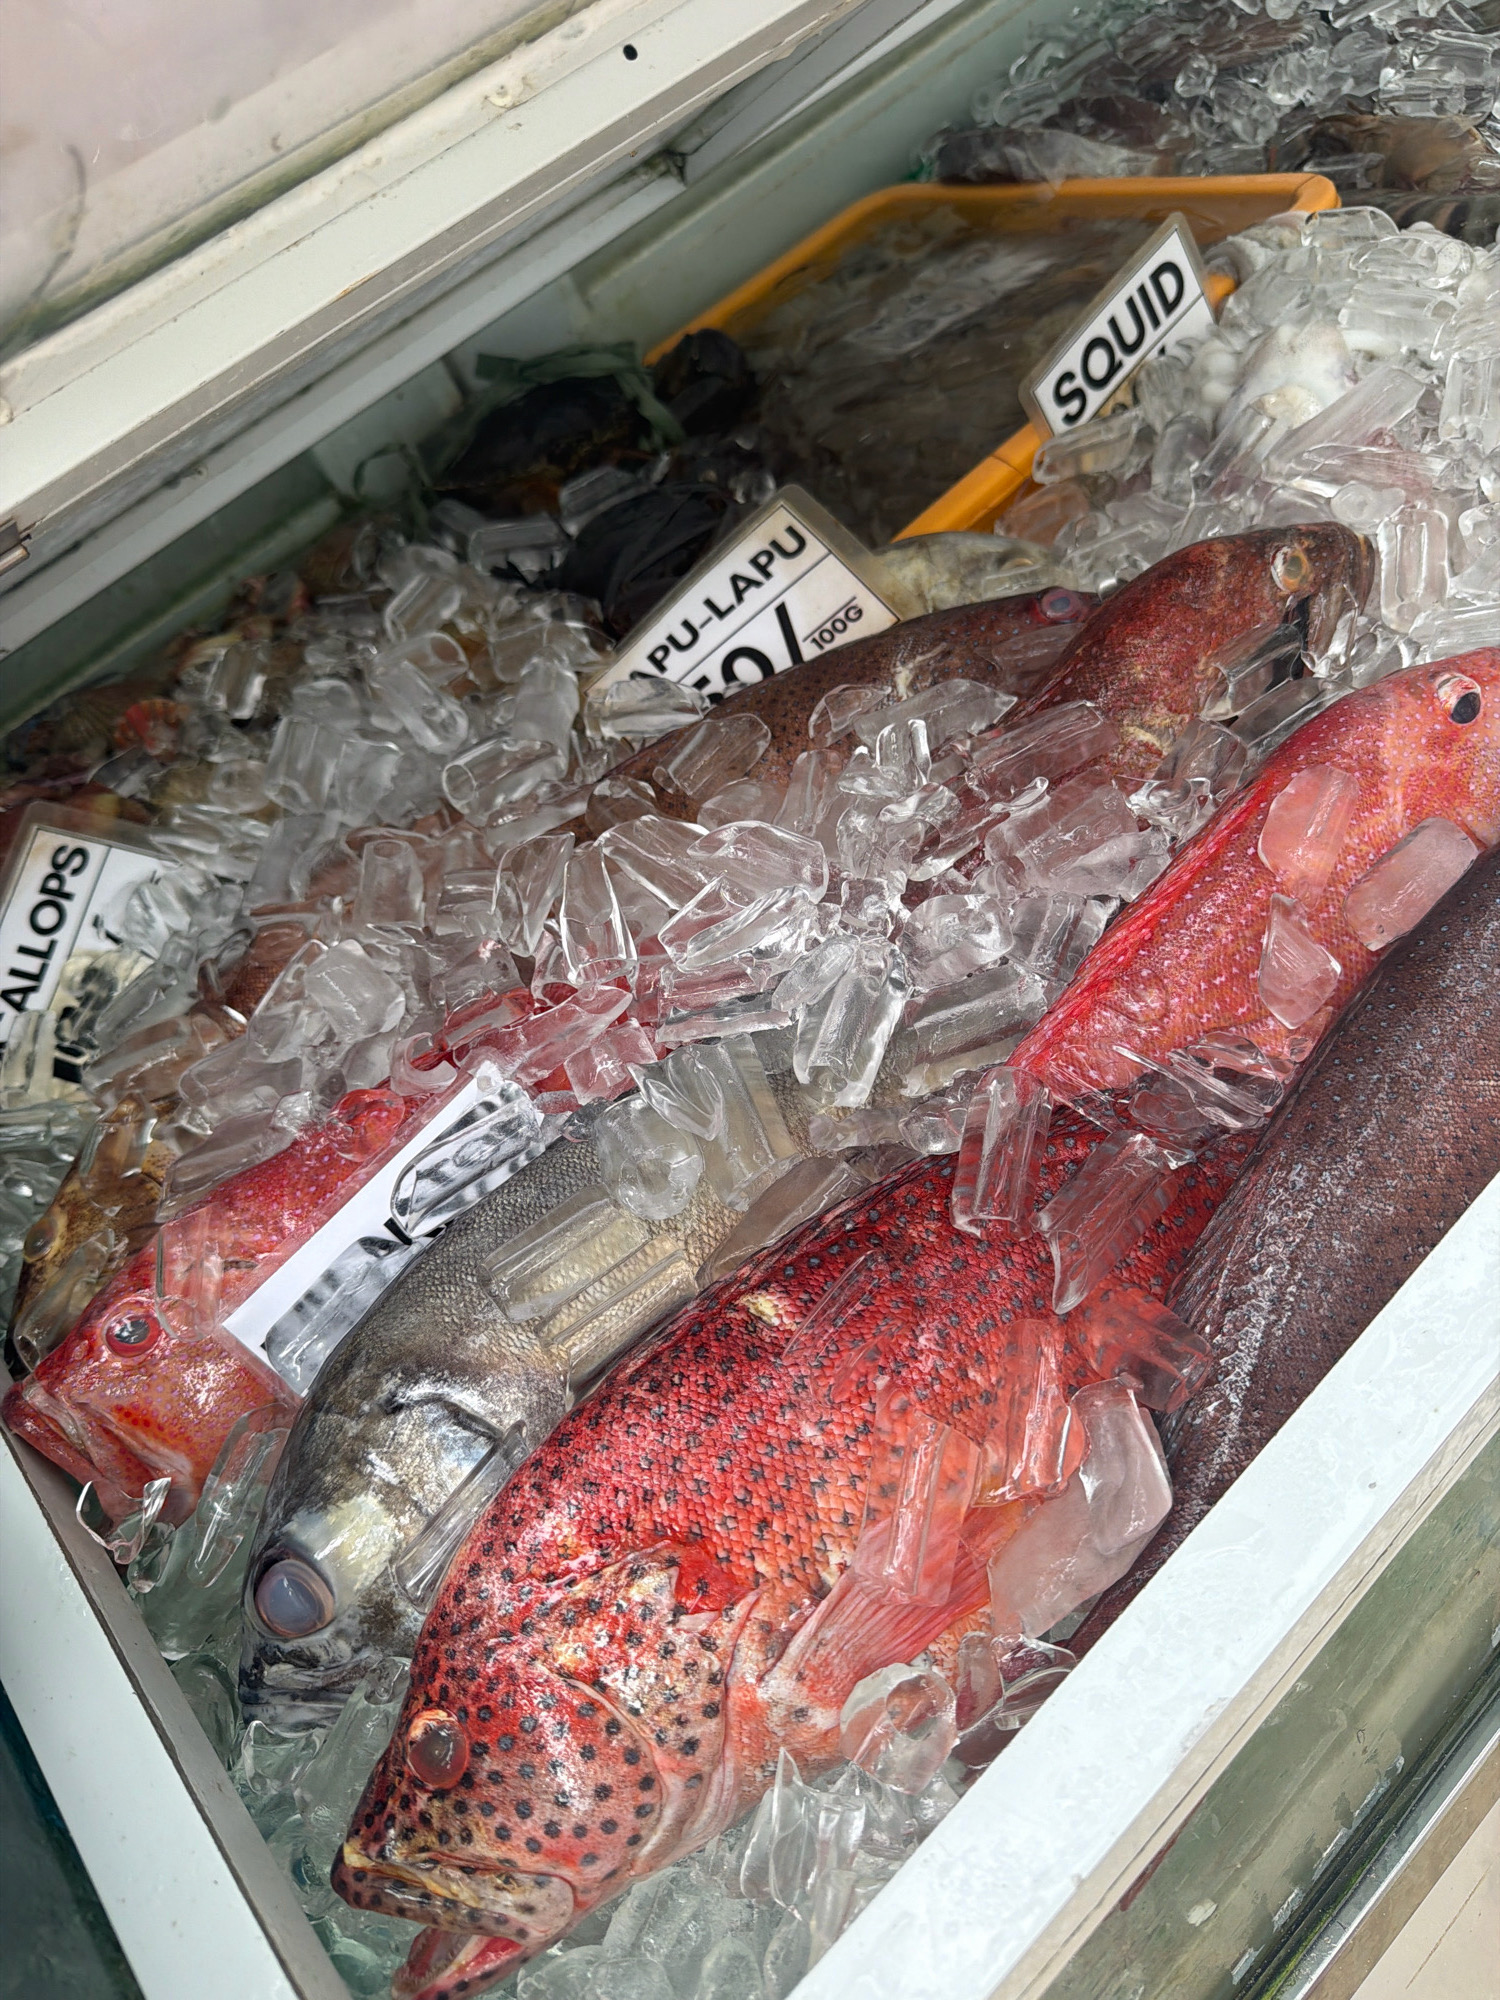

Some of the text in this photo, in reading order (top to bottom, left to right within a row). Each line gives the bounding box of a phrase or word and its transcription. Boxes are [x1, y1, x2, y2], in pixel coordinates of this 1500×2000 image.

[1052, 261, 1185, 427] SQUID
[628, 525, 807, 681] APU-LAPU
[810, 605, 864, 651] 100G
[0, 844, 91, 1048] ALLOPS
